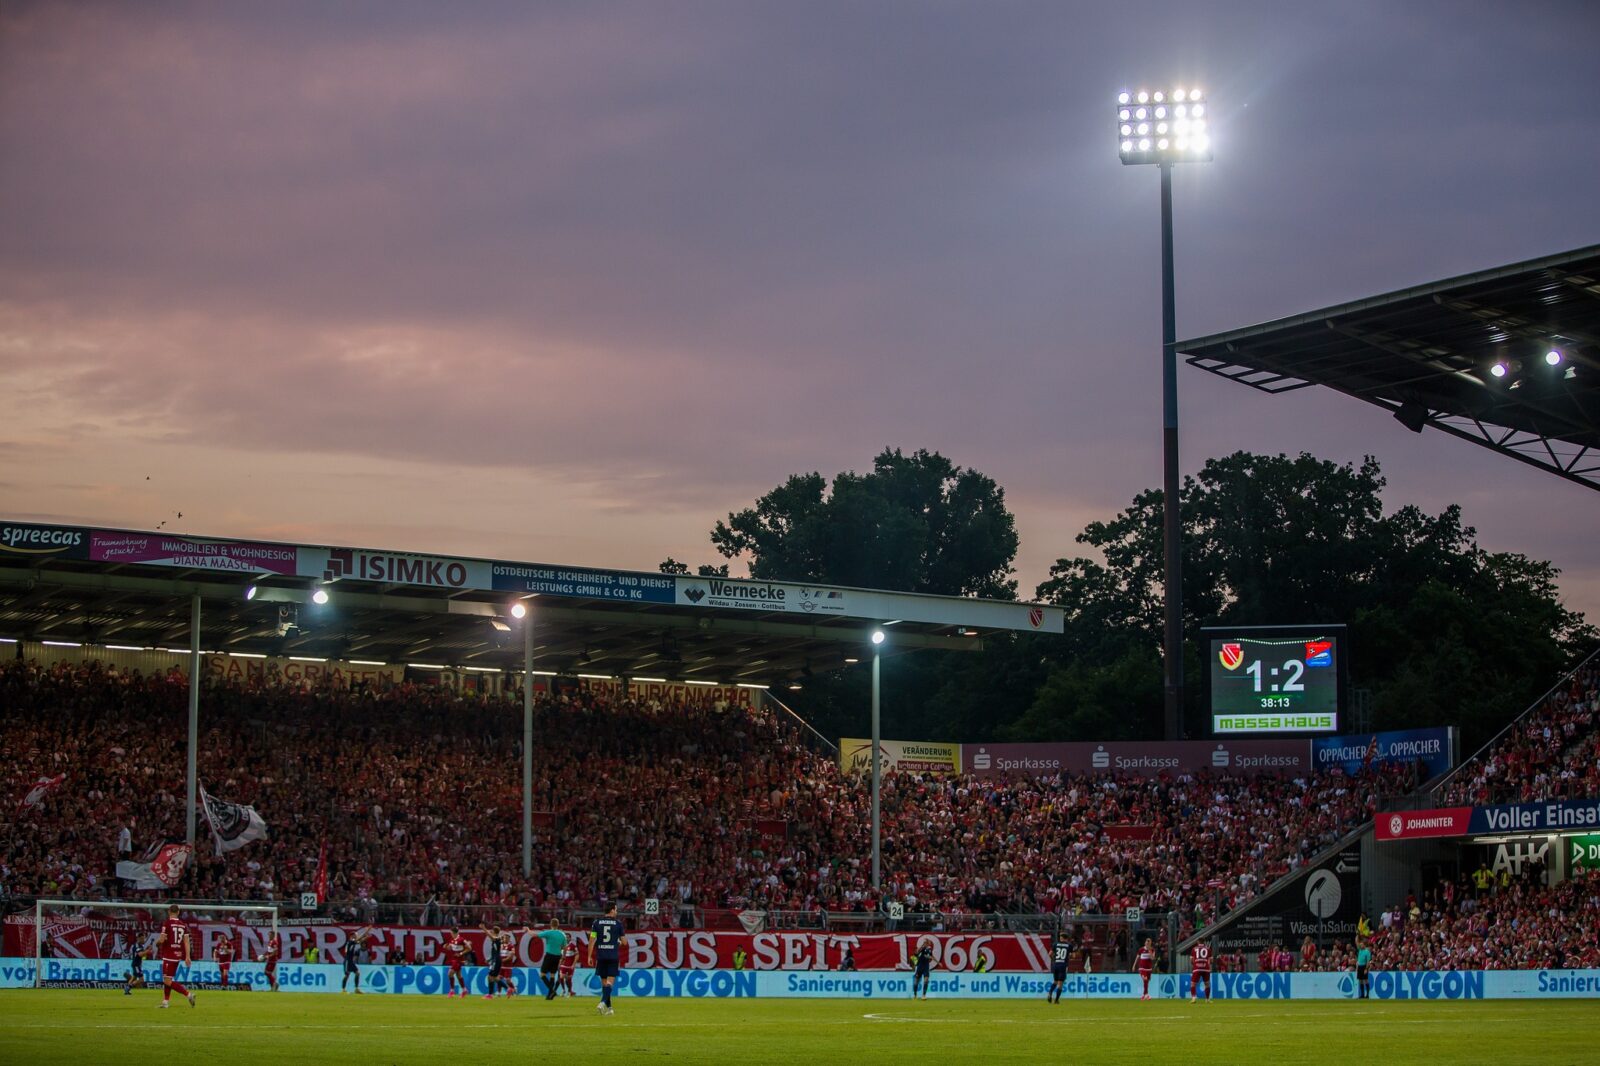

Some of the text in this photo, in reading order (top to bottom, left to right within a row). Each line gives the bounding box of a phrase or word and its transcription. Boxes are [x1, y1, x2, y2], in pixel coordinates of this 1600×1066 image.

[161, 541, 295, 561] IMMOBILIEN & WOHNDESIGN
[173, 554, 256, 571] DIANA MAASCH
[360, 554, 467, 587] ISIMKO
[493, 565, 675, 590] OSTDEUTSCHE SICHERHEITS- UND DIENST-
[526, 581, 643, 599] LEISTUNGS GMBH & CO. KG
[708, 580, 786, 600] Wernecke
[708, 599, 730, 607] Wildau
[761, 602, 786, 610] Cottbus
[1246, 659, 1305, 692] 1:2
[1260, 698, 1290, 708] 38:13
[1220, 717, 1281, 729] massa
[902, 745, 953, 757] VERÄNDERUNG
[1319, 745, 1367, 763] OPPACHER
[1390, 739, 1441, 757] OPPACHER
[997, 757, 1060, 771] Sparkasse
[1115, 756, 1180, 771] Sparkasse
[1235, 754, 1300, 769] Sparkasse
[1406, 816, 1453, 830] JOHANNITER
[1485, 806, 1540, 830] Voller
[303, 895, 316, 907] 22
[646, 901, 658, 913] 23
[891, 906, 902, 918] 24
[1127, 909, 1140, 920] 25
[172, 926, 185, 944] 13
[602, 925, 612, 943] 5
[1289, 920, 1358, 935] WaschSalon
[199, 923, 447, 965] ENERGIE
[483, 928, 719, 970] COBUS
[752, 931, 861, 971] SEIT
[1055, 947, 1068, 960] 30
[1193, 948, 1209, 959] 10
[3, 962, 327, 987] von Brand- nd Wasserscäden
[611, 969, 757, 998] POLYGON
[788, 973, 1132, 997] Sanierung von and- und Wasseschäden
